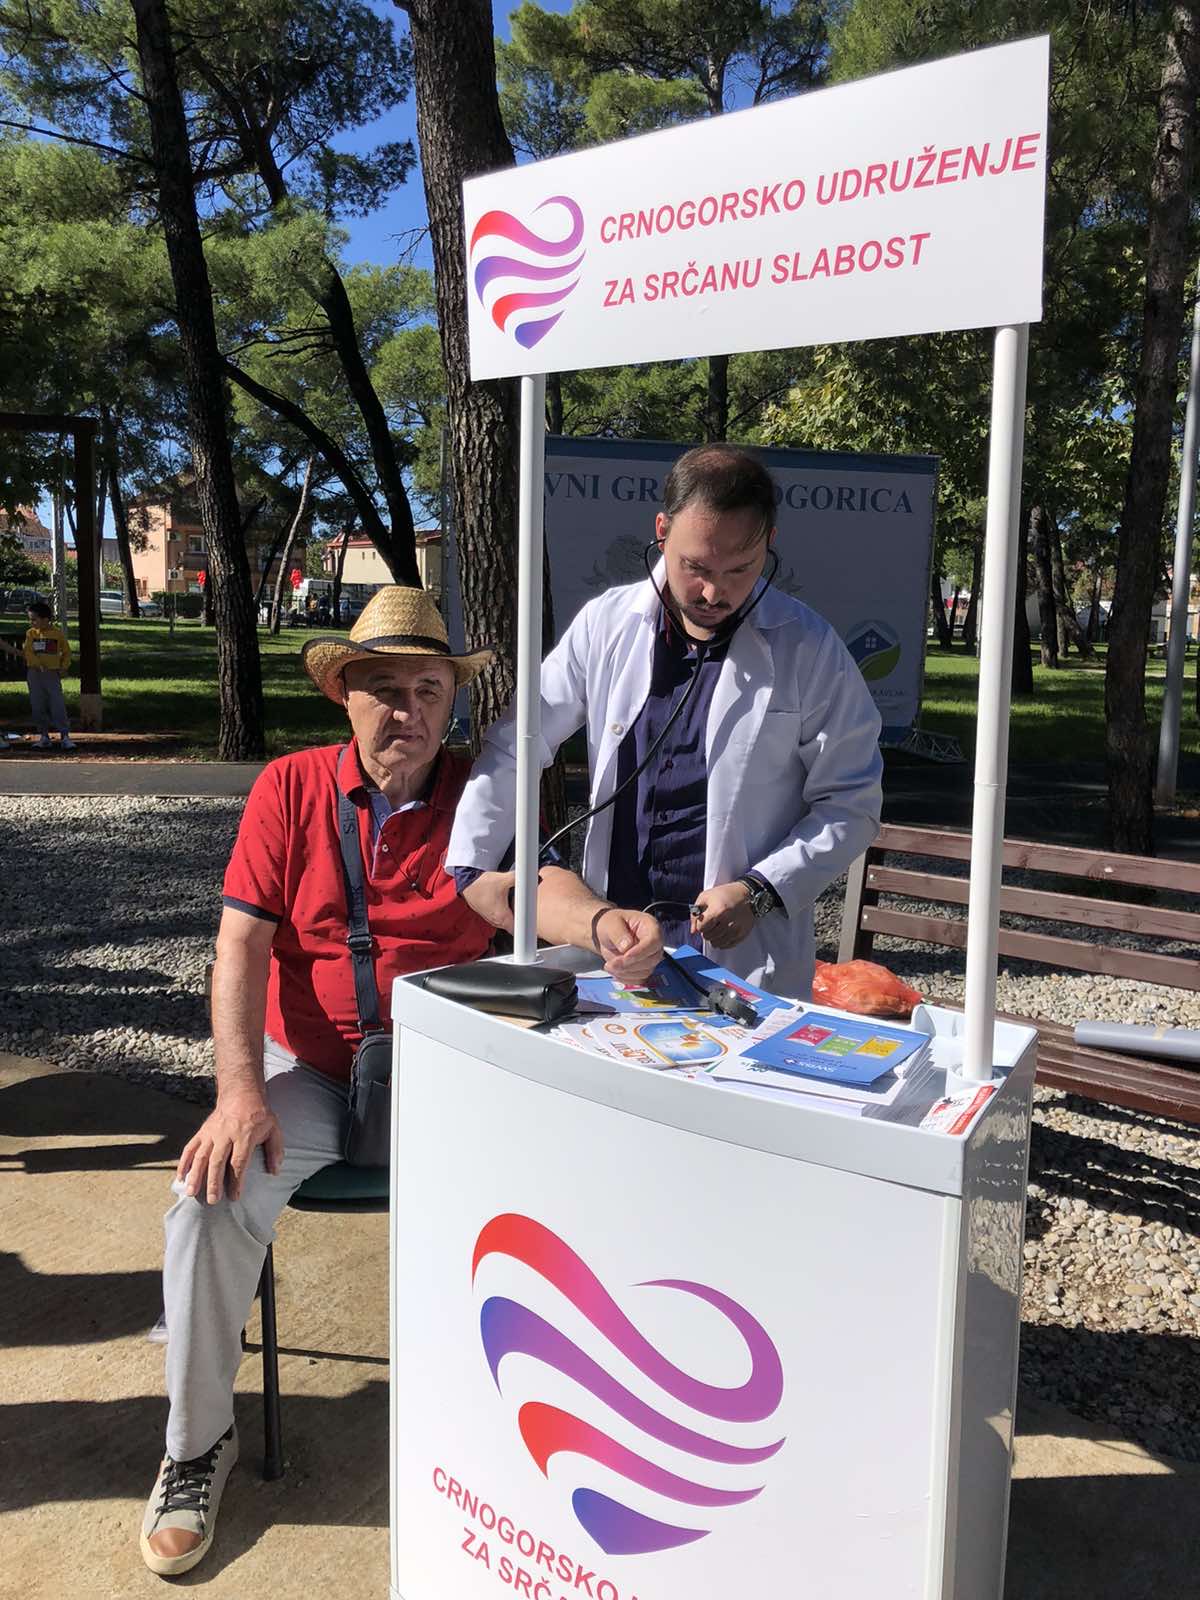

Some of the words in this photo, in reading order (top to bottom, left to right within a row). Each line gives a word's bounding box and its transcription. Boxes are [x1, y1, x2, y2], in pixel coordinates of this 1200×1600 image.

[600, 180, 806, 245] CRNOGORSKO
[815, 132, 1041, 206] UDRUŽENJE
[602, 277, 635, 308] ZA
[643, 259, 763, 302] SRČANU
[770, 232, 931, 285] SLABOST
[611, 476, 665, 503] GR
[432, 1466, 619, 1600] CRNOGORSKO
[461, 1527, 490, 1569] ZA
[498, 1556, 567, 1600] SRČ
